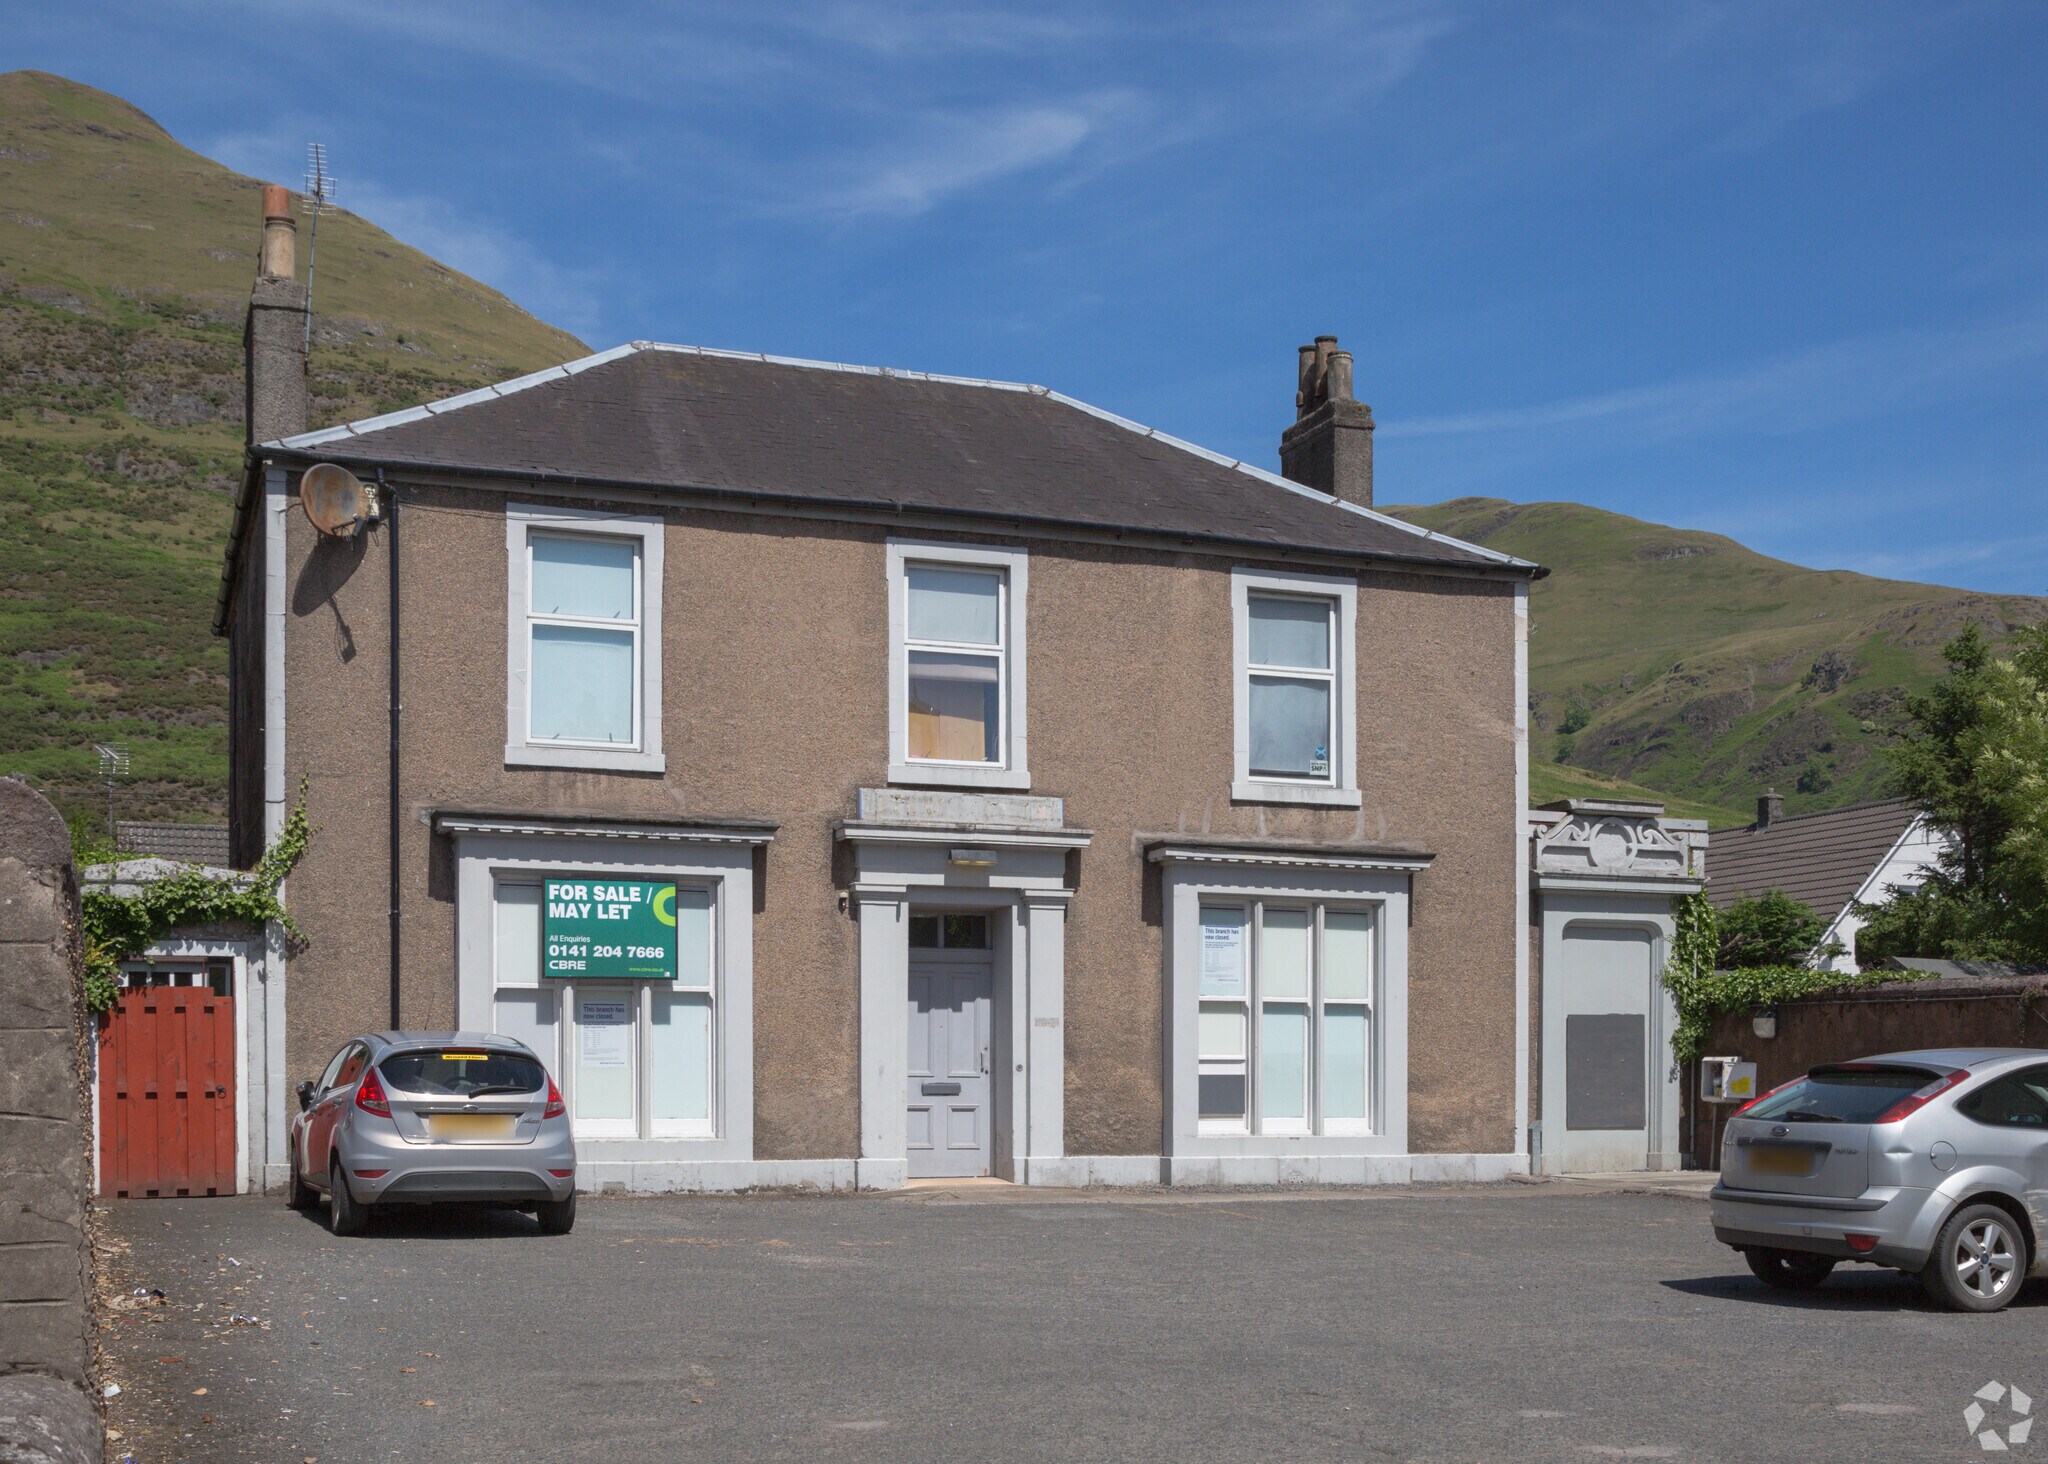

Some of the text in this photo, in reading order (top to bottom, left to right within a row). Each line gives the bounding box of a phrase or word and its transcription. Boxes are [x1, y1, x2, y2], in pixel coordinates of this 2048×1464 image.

[549, 885, 653, 904] FOR SALE /
[549, 902, 632, 920] MAY LET
[559, 935, 591, 943] Enquiries
[549, 945, 665, 959] 0141 204 7666
[549, 960, 586, 970] CBRE
